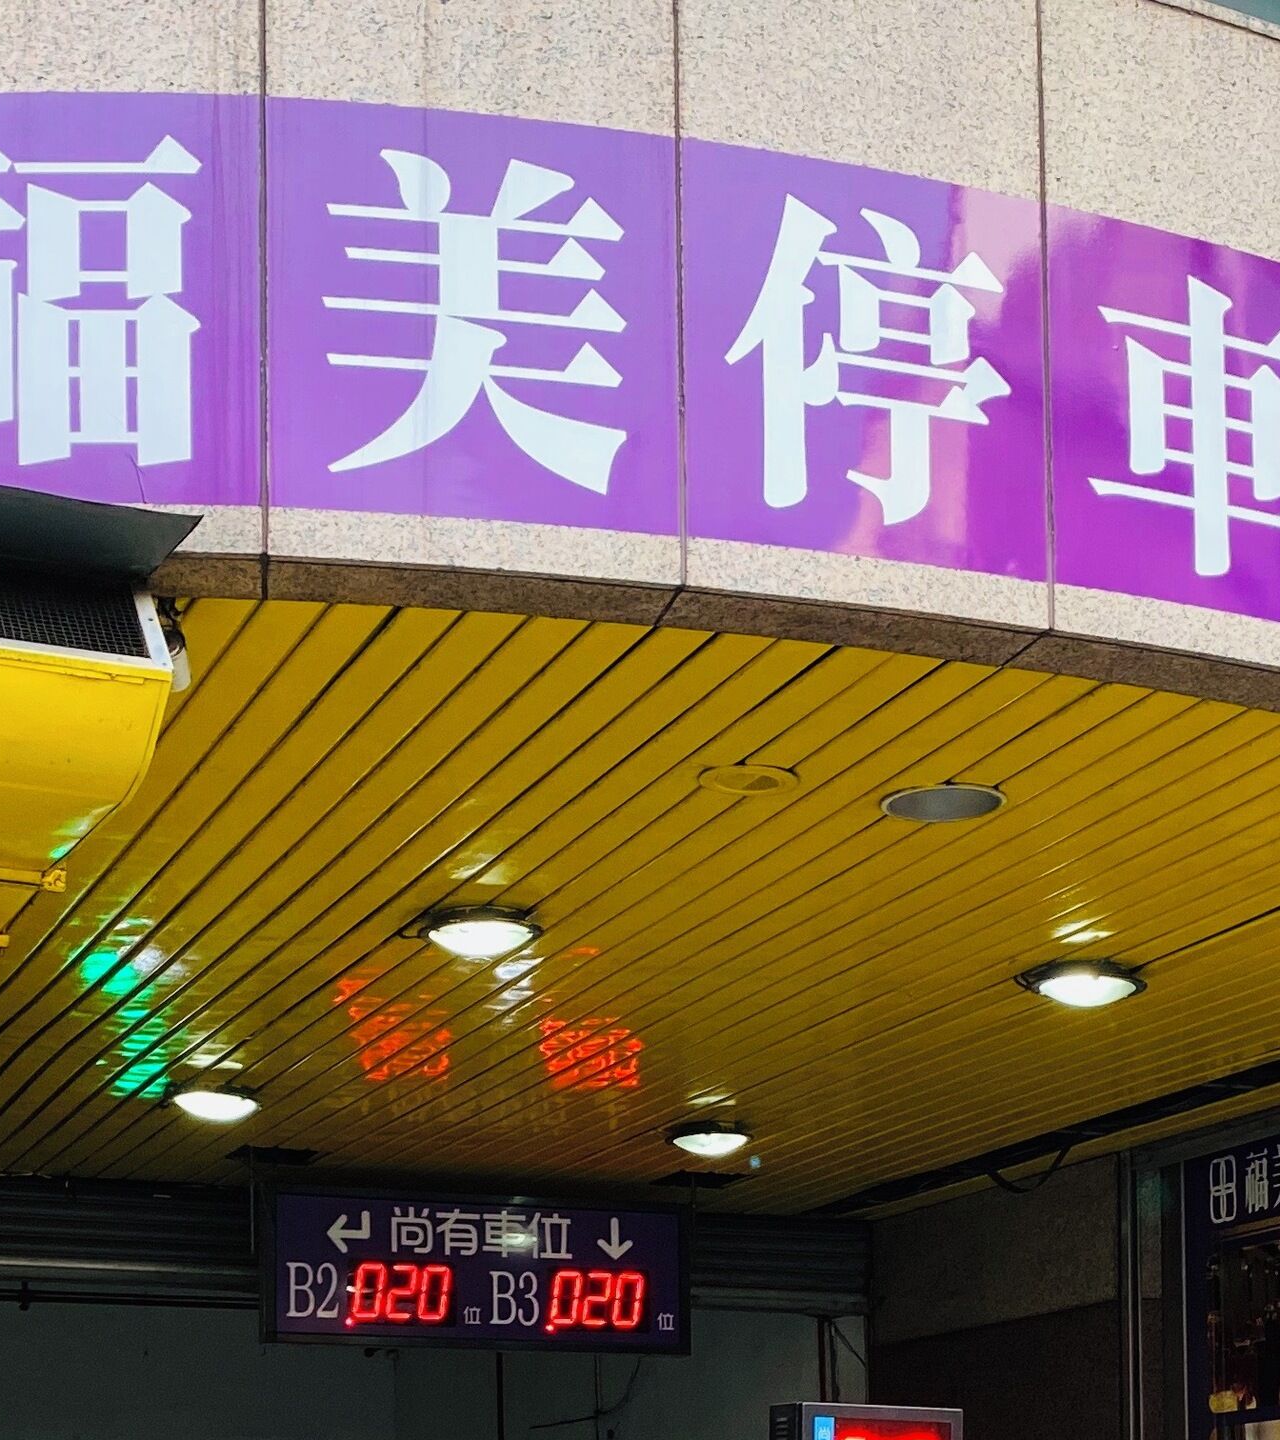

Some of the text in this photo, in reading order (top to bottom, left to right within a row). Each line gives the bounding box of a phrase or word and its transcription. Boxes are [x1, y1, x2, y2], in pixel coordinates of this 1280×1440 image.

[390, 1206, 573, 1259] 尚有車位
[286, 1262, 675, 1331] B2 020 位 B3 020 位
